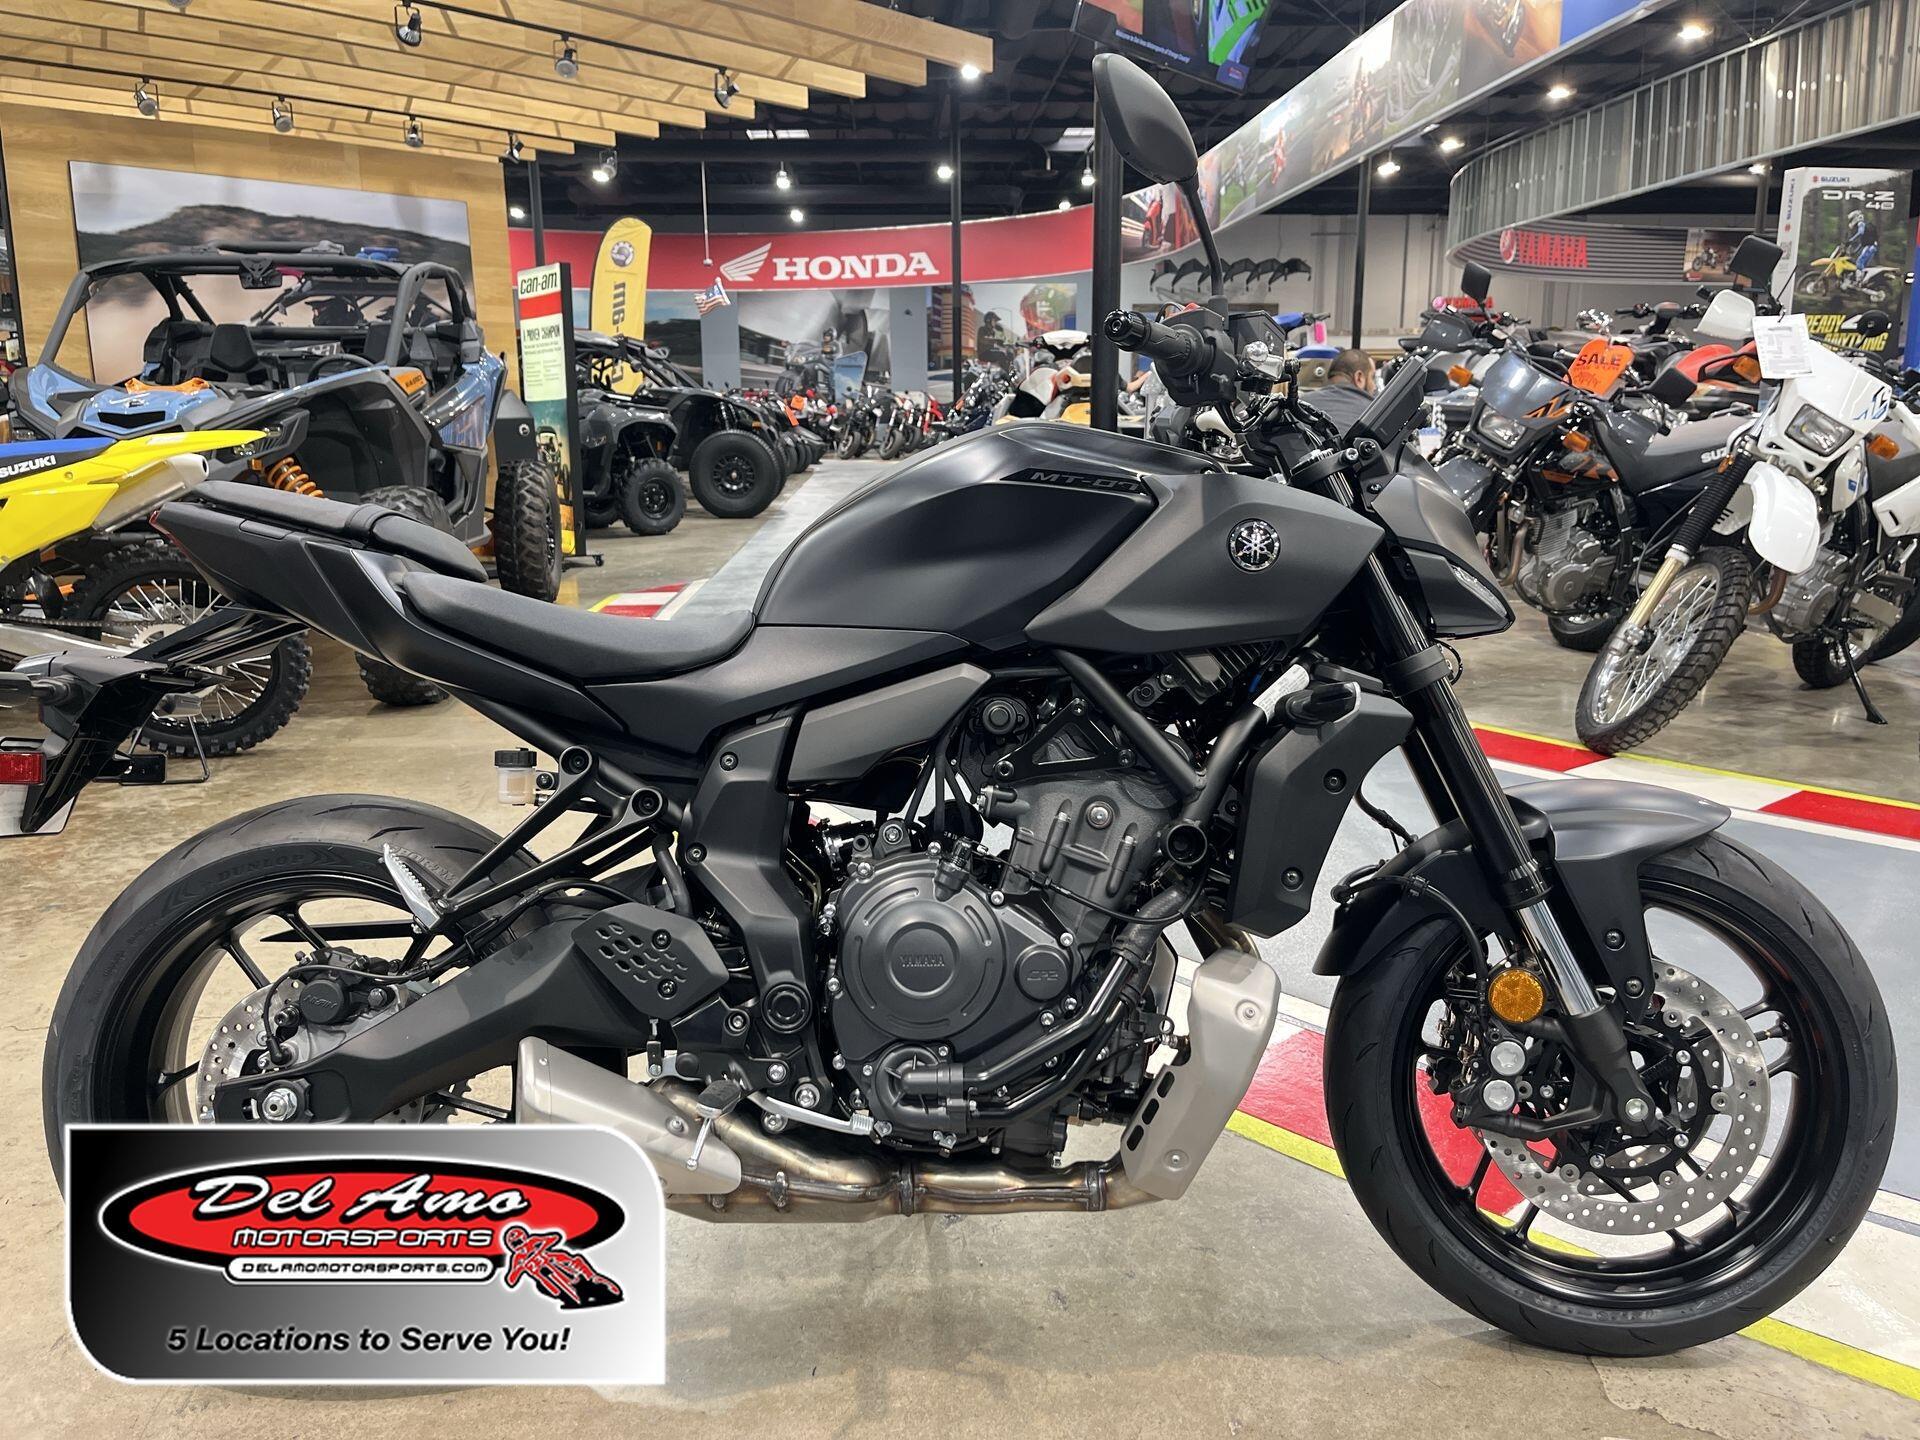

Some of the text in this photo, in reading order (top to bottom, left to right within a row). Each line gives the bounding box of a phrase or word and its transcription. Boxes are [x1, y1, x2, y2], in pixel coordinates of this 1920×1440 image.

[1822, 189, 1895, 202] DR-Z
[1516, 231, 1589, 268] YAMAHA
[772, 252, 939, 281] HONDA
[520, 272, 557, 294] can-am
[1576, 353, 1623, 367] SALE
[0, 455, 57, 478] SUZUKI
[1030, 472, 1139, 491] MT-07
[218, 853, 305, 880] DUNLOP
[901, 953, 945, 967] YAMAHA
